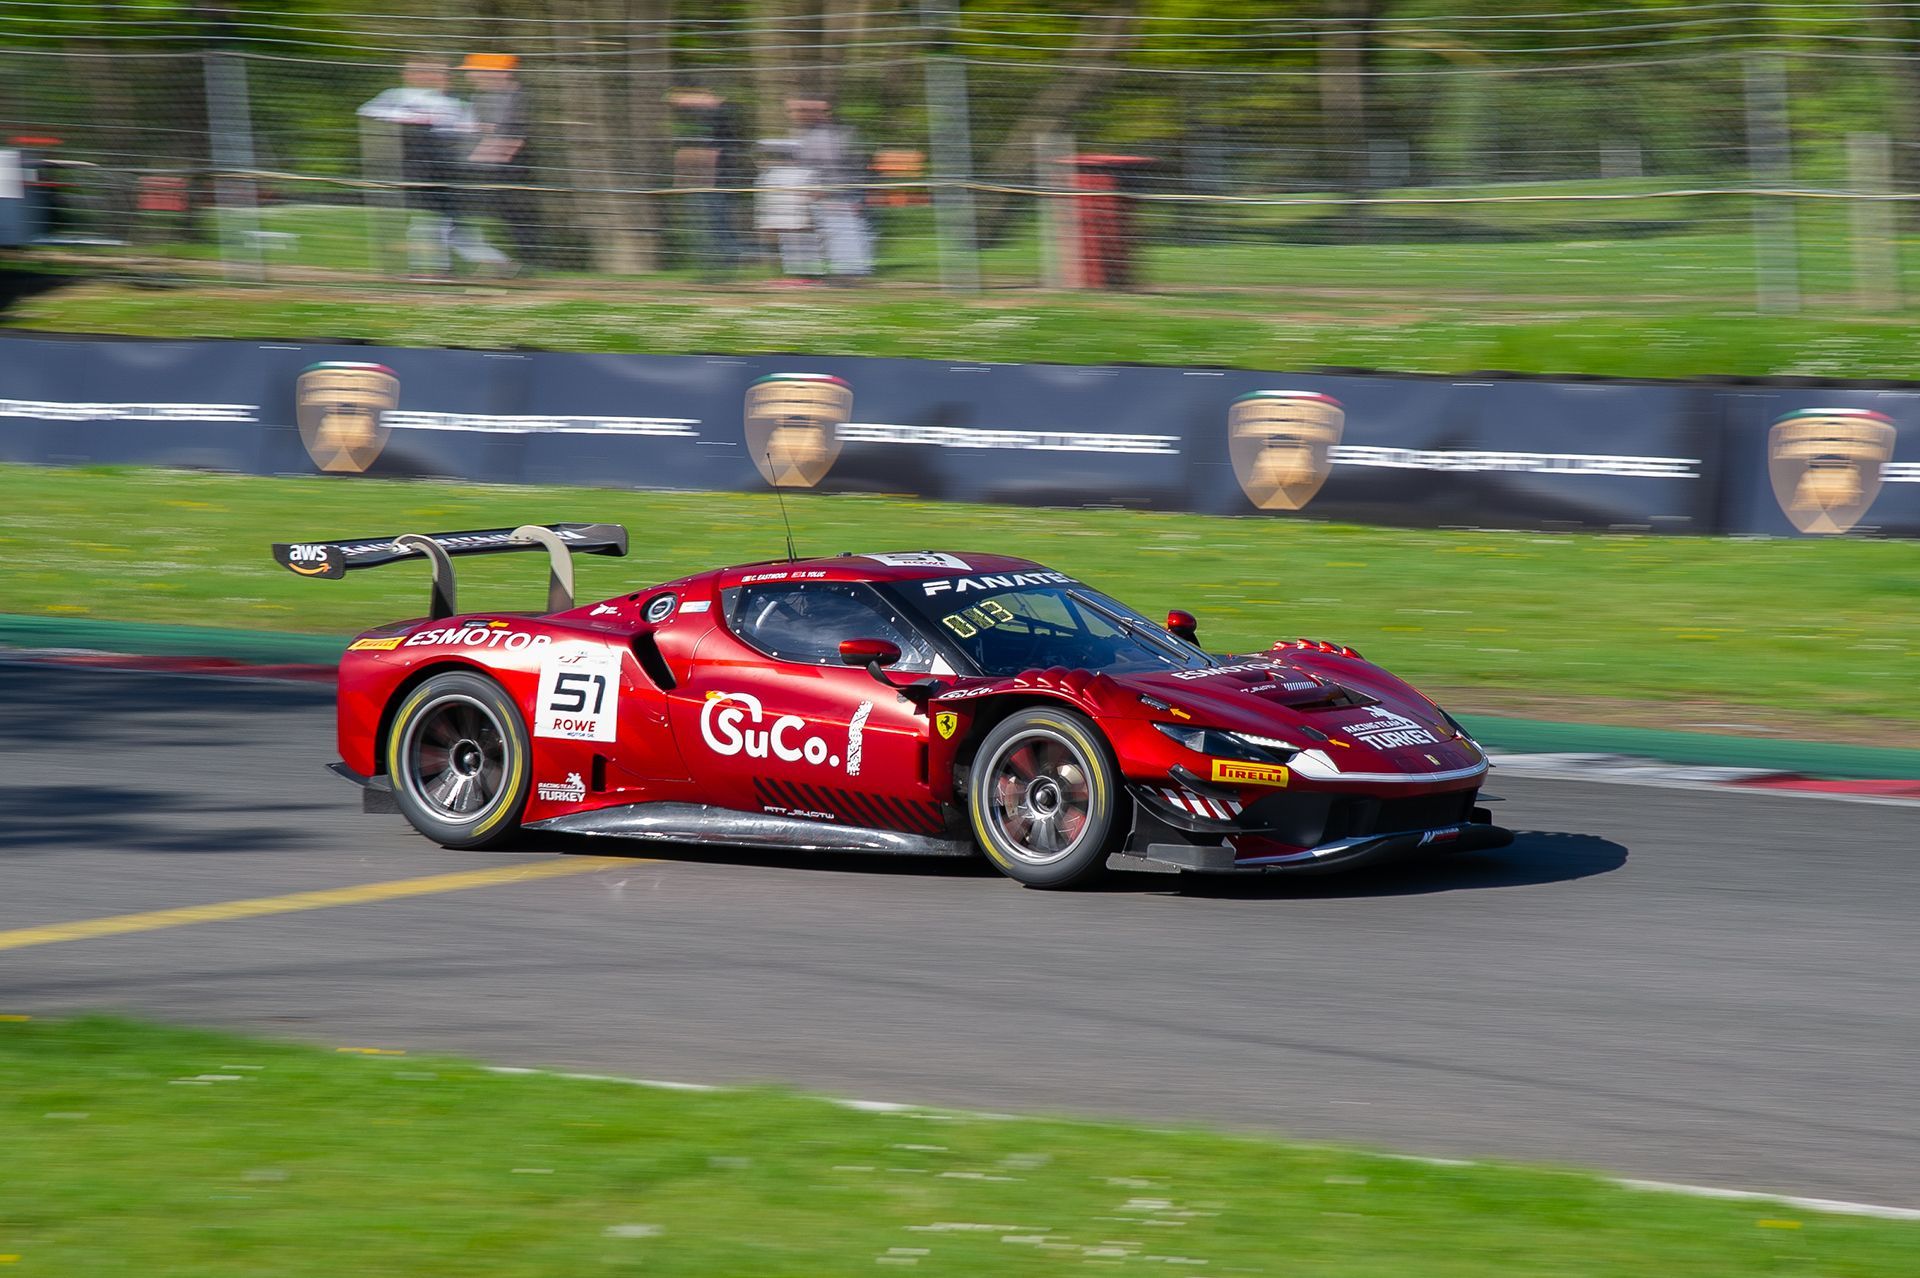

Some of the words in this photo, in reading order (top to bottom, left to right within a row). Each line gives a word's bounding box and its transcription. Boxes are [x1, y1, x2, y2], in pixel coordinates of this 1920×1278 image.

[289, 543, 328, 561] aws
[922, 572, 1079, 597] FANATEC
[550, 672, 607, 714] 51
[553, 718, 597, 732] ROWE
[700, 691, 840, 767] SuCo.
[1342, 722, 1380, 734] RACING
[1374, 720, 1405, 729] TEAM
[1358, 729, 1440, 750] TURKEY
[1219, 764, 1281, 782] PIRELLI
[537, 790, 586, 802] TURKEY
